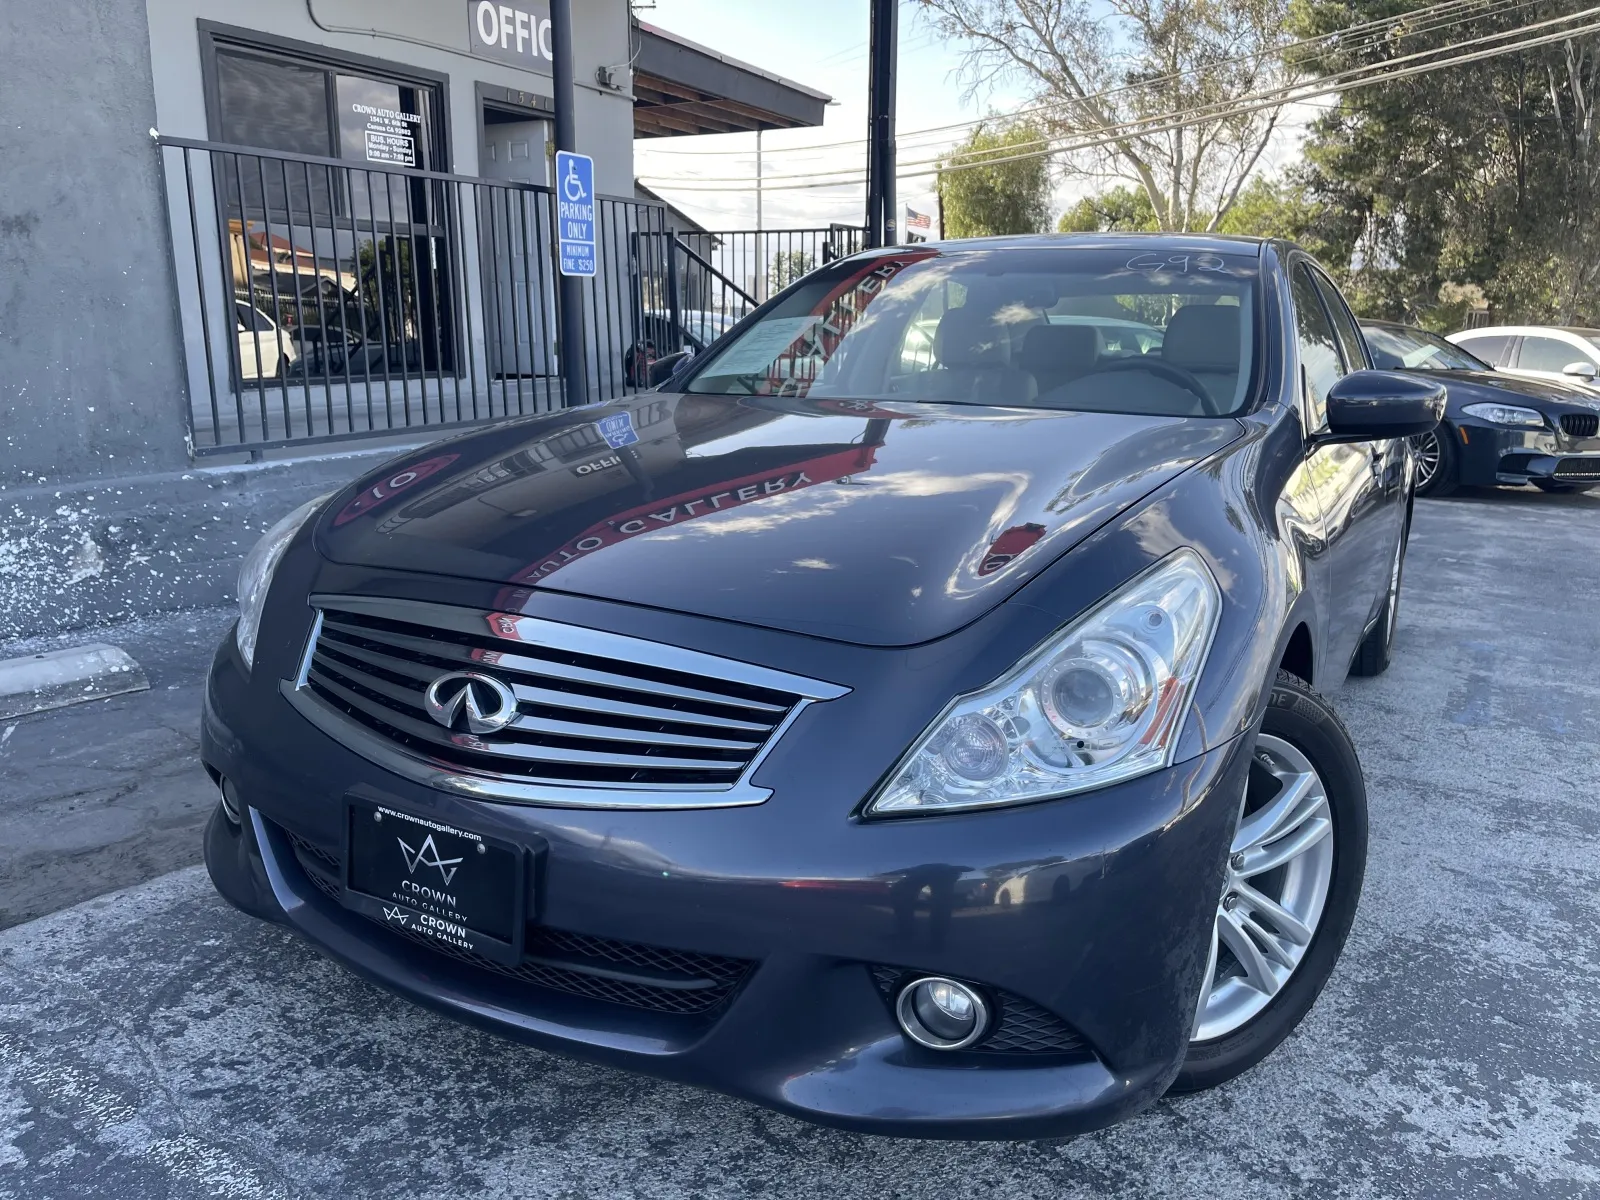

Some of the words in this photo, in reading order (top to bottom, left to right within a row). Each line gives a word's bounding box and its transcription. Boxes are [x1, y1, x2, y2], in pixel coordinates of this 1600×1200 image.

[477, 0, 553, 61] OFFIC
[352, 104, 376, 115] CROWN
[377, 109, 394, 118] AUTO
[395, 112, 420, 123] GALLERY
[370, 116, 383, 124] 1541
[386, 125, 395, 133] CA
[368, 142, 388, 152] Monday
[393, 145, 412, 155] Sunday
[370, 135, 385, 144] BUS.
[386, 137, 409, 148] HOURS
[560, 201, 593, 222] PARKING
[567, 221, 587, 239] ONLY
[566, 244, 590, 257] MINIMUM
[563, 258, 575, 270] FINE
[578, 259, 594, 271] $250
[377, 805, 482, 842] www.crownautogallery.com
[401, 880, 456, 908] CROWN
[392, 892, 418, 906] AUTO
[422, 902, 468, 922] GALLERY
[420, 914, 466, 938] CROWN
[411, 923, 433, 935] AUTO
[436, 932, 474, 950] GALLERY
